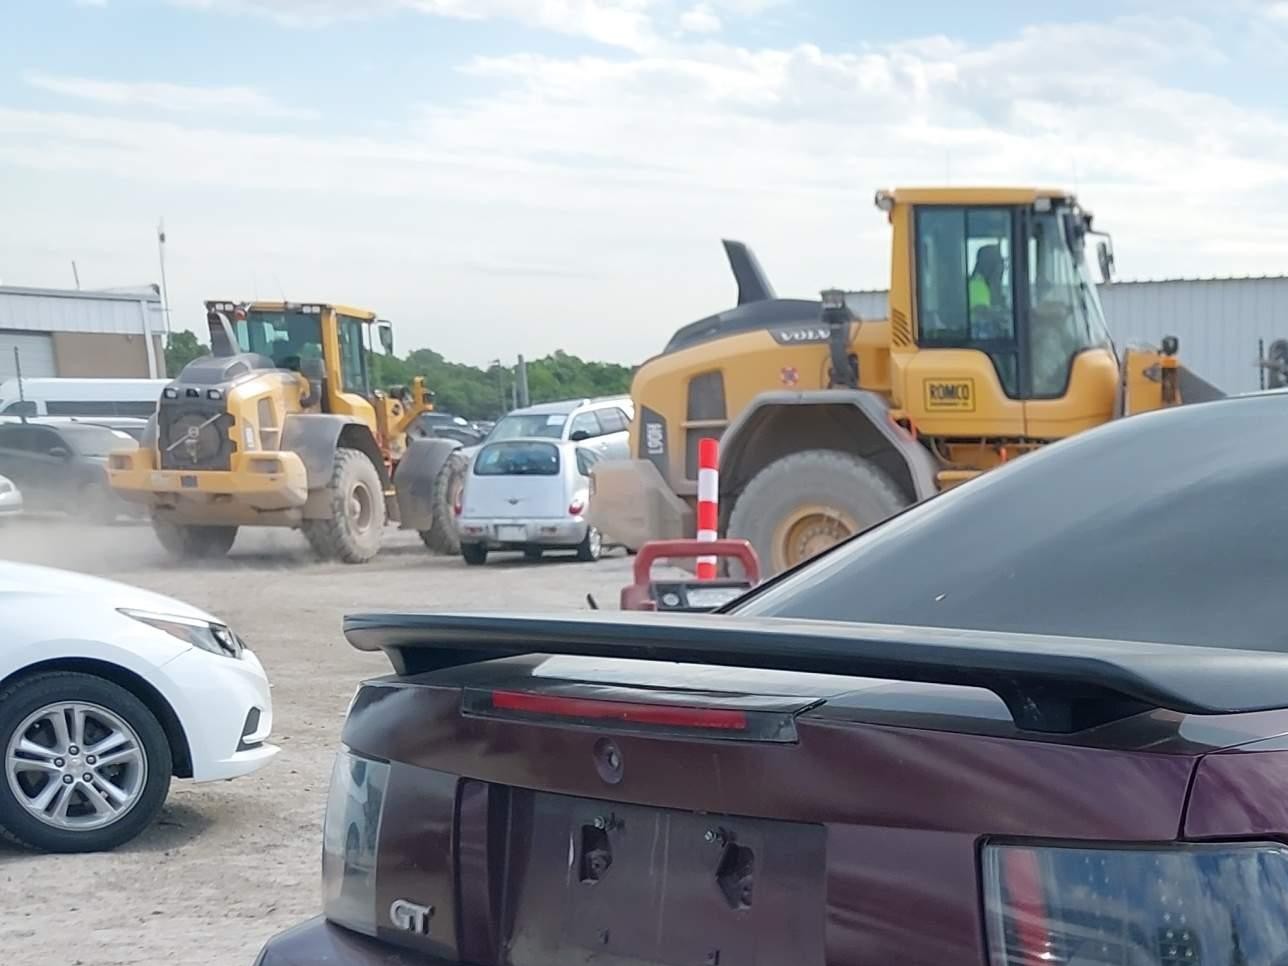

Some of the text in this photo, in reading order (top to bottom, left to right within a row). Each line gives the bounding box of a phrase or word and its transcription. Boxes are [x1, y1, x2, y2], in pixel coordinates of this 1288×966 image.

[781, 329, 831, 341] VOLV
[929, 384, 970, 401] ROMCO
[390, 899, 433, 934] GT
